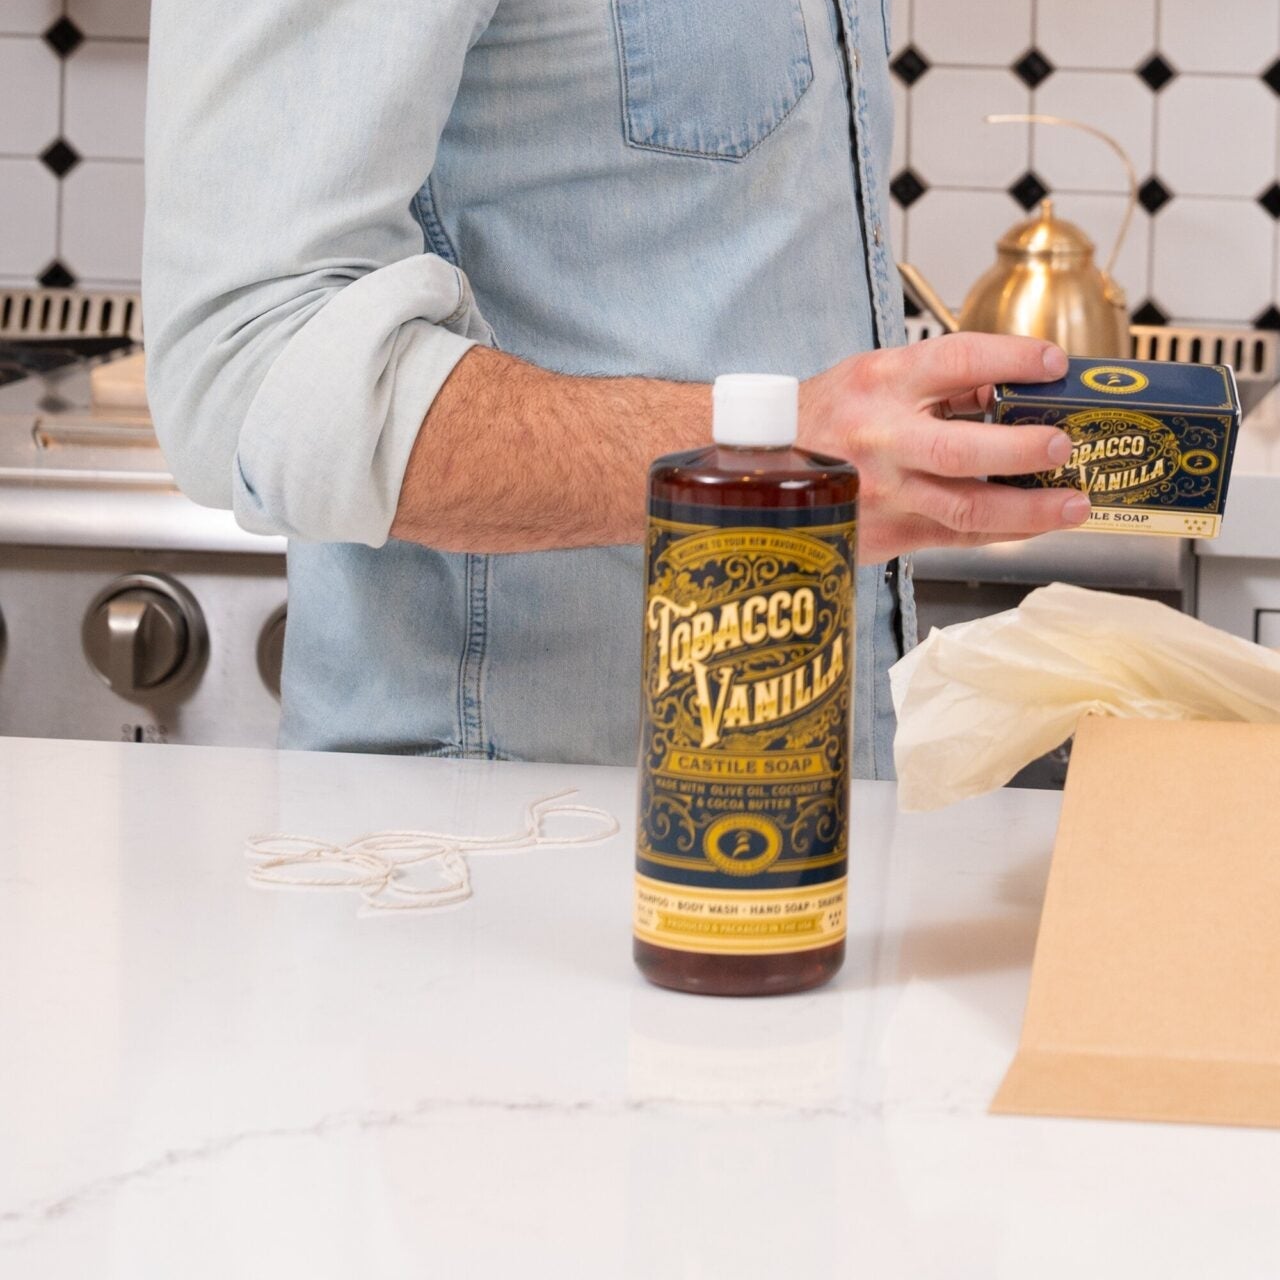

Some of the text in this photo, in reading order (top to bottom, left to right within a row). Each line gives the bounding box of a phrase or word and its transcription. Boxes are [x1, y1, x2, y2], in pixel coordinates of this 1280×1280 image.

[1077, 458, 1164, 495] VANILLA
[1114, 513, 1149, 522] SOAP
[724, 536, 746, 547] YOUR
[750, 535, 767, 546] NEW
[648, 587, 815, 694] TOBACCO
[685, 633, 845, 748] VANILLA
[678, 755, 813, 774] CASTILE SOAP
[710, 784, 744, 797] OLIVE
[707, 797, 744, 810] COCOA
[748, 798, 791, 810] BUTTER
[678, 900, 704, 912] BODY
[708, 904, 738, 915] WASH
[750, 903, 781, 915] HAND
[784, 900, 810, 913] SOAP
